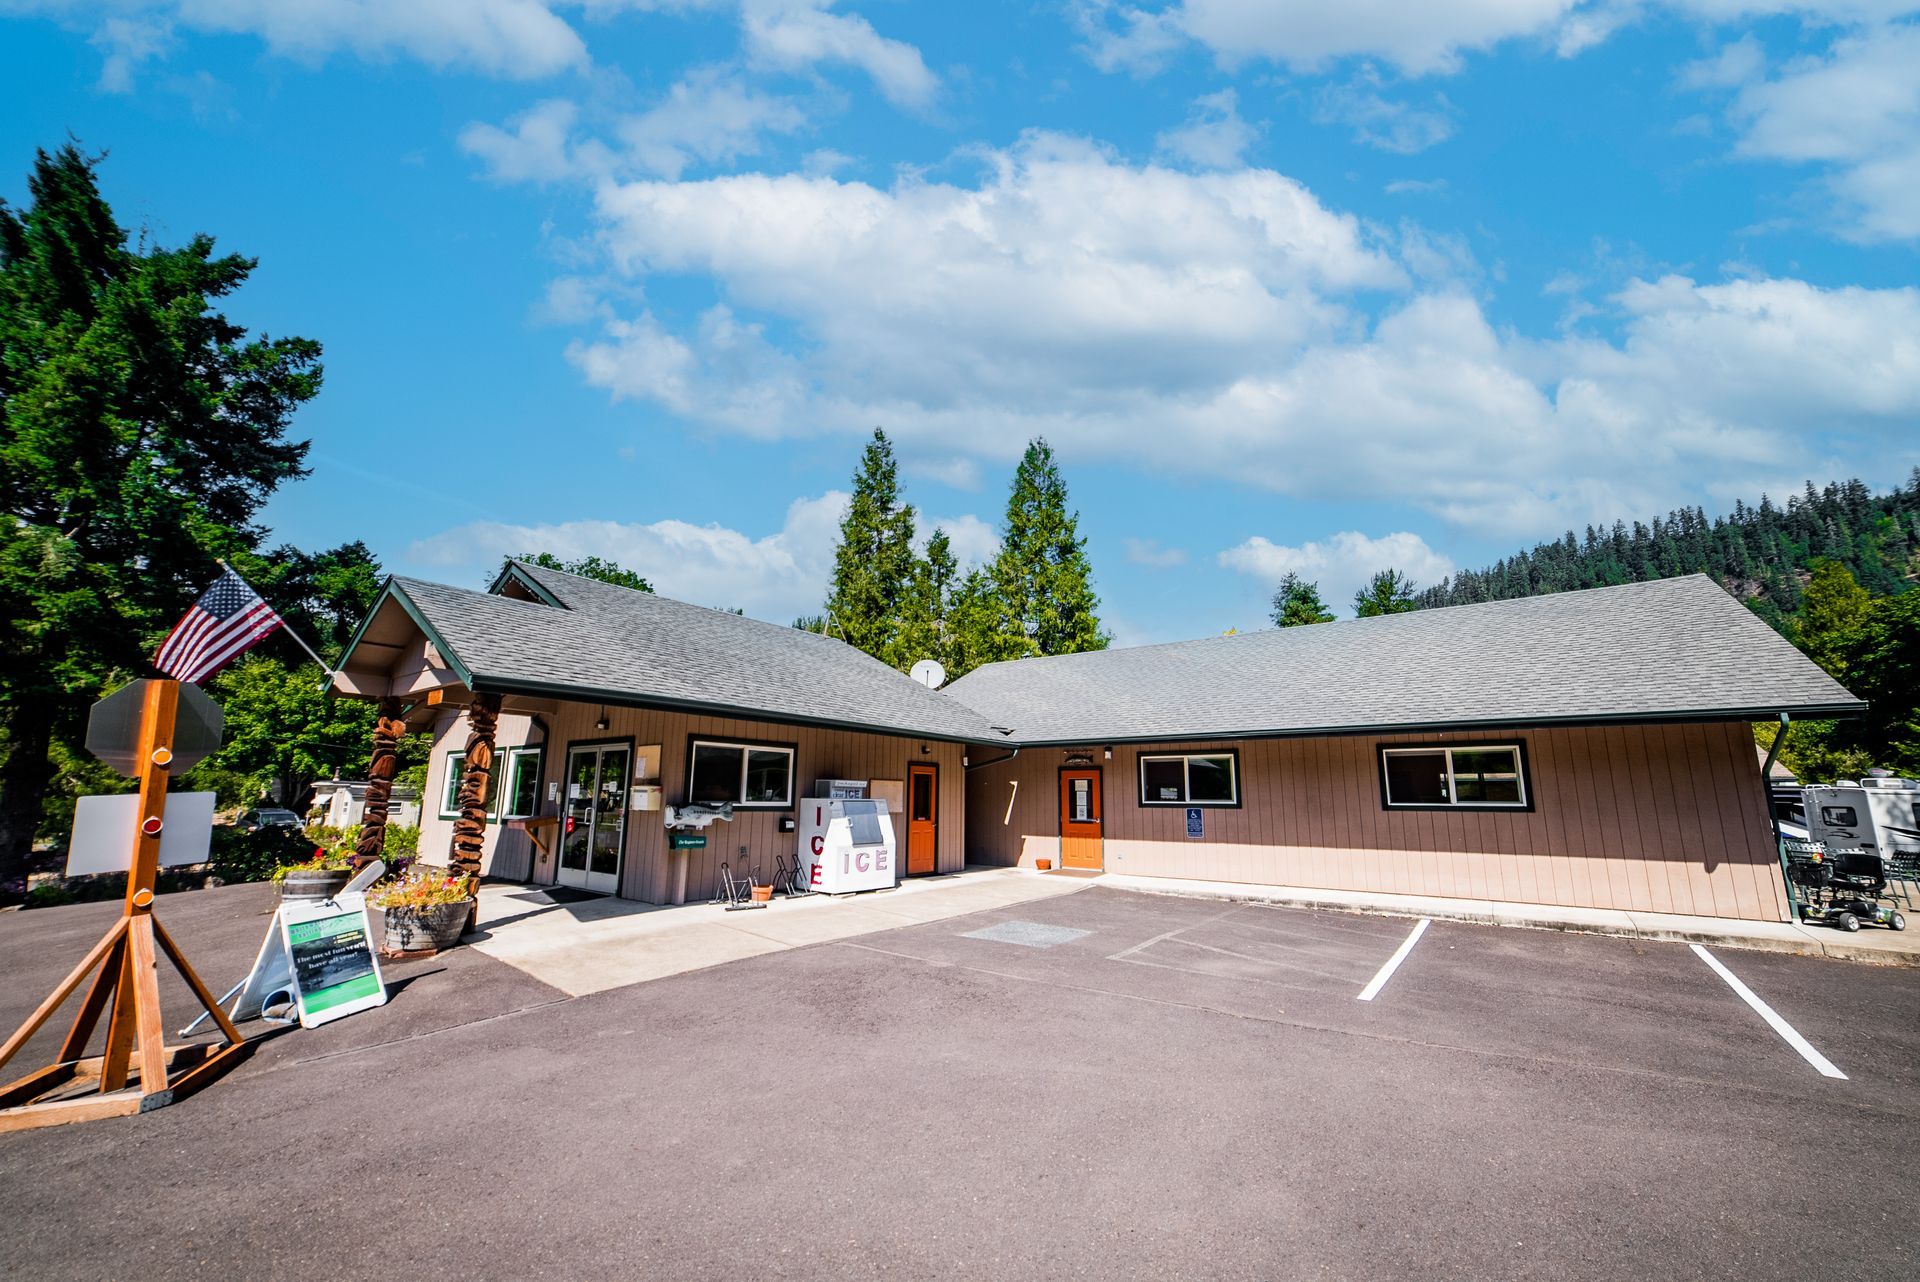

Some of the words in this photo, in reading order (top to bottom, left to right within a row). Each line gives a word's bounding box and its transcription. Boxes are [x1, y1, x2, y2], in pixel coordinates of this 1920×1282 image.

[845, 789, 860, 799] ICE
[811, 806, 824, 885] ICE
[844, 849, 888, 874] ICE
[297, 956, 311, 964] The
[312, 951, 332, 960] most
[309, 961, 327, 969] have
